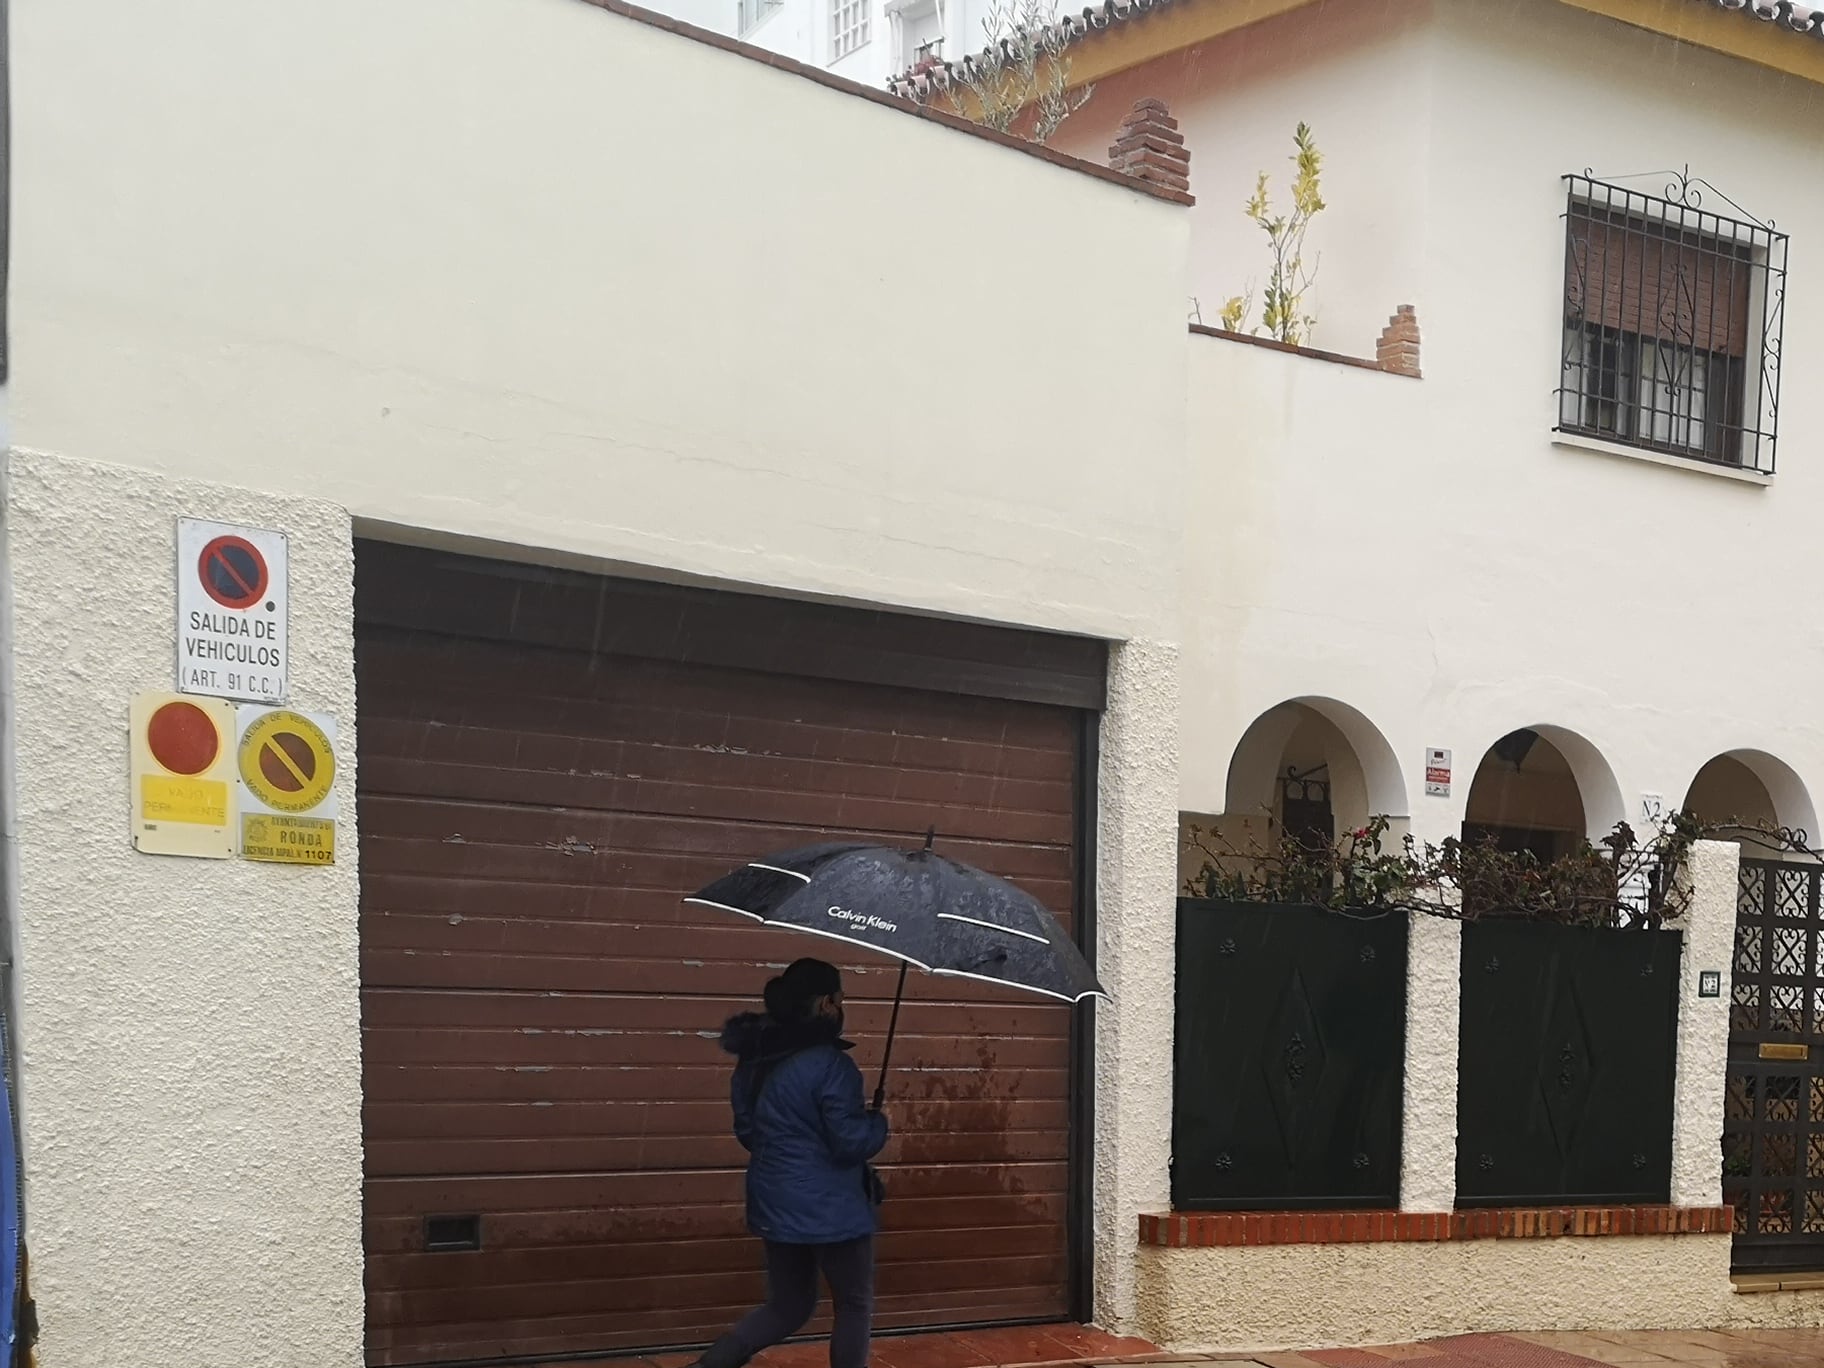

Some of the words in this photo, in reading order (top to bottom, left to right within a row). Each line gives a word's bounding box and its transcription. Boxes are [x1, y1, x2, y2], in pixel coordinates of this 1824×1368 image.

[190, 611, 250, 637] SALIDA
[255, 620, 276, 640] DE
[186, 637, 280, 667] VEHICULOS
[228, 673, 241, 690] 91
[270, 712, 281, 722] DE
[246, 779, 269, 802] VADO
[280, 830, 323, 847] RONDA
[305, 850, 332, 860] 1107
[827, 905, 867, 924] Calvin
[866, 914, 897, 932] Klein
